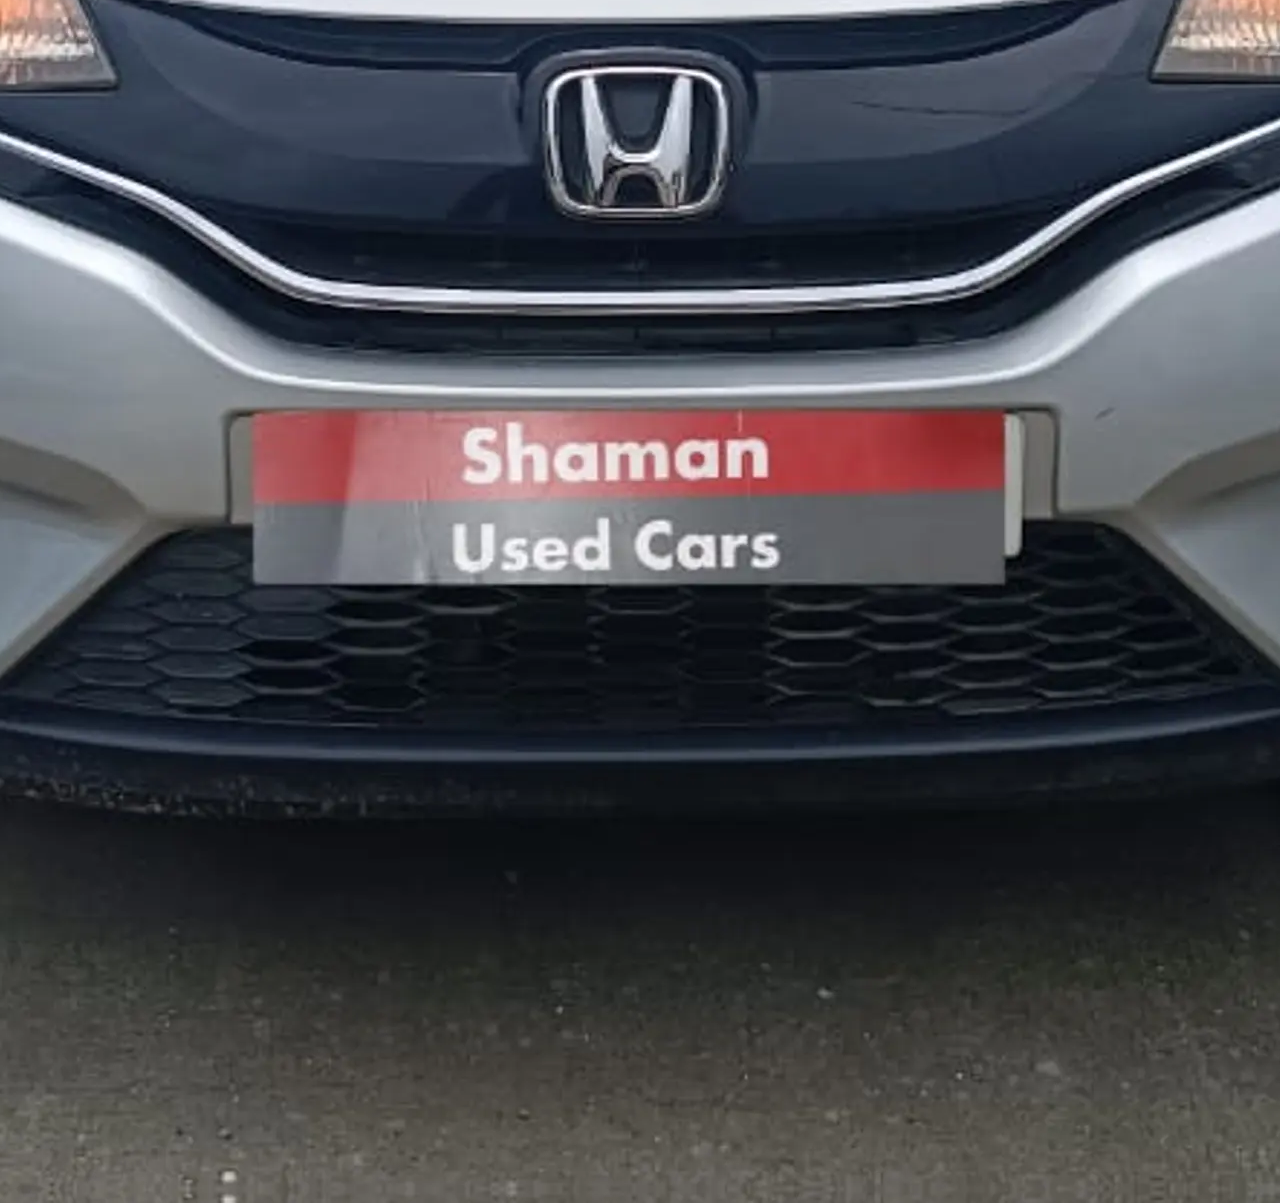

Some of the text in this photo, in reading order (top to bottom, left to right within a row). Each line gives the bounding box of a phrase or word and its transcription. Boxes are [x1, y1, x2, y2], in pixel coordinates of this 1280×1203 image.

[462, 422, 770, 485] Shaman
[452, 517, 781, 573] Used Cars
